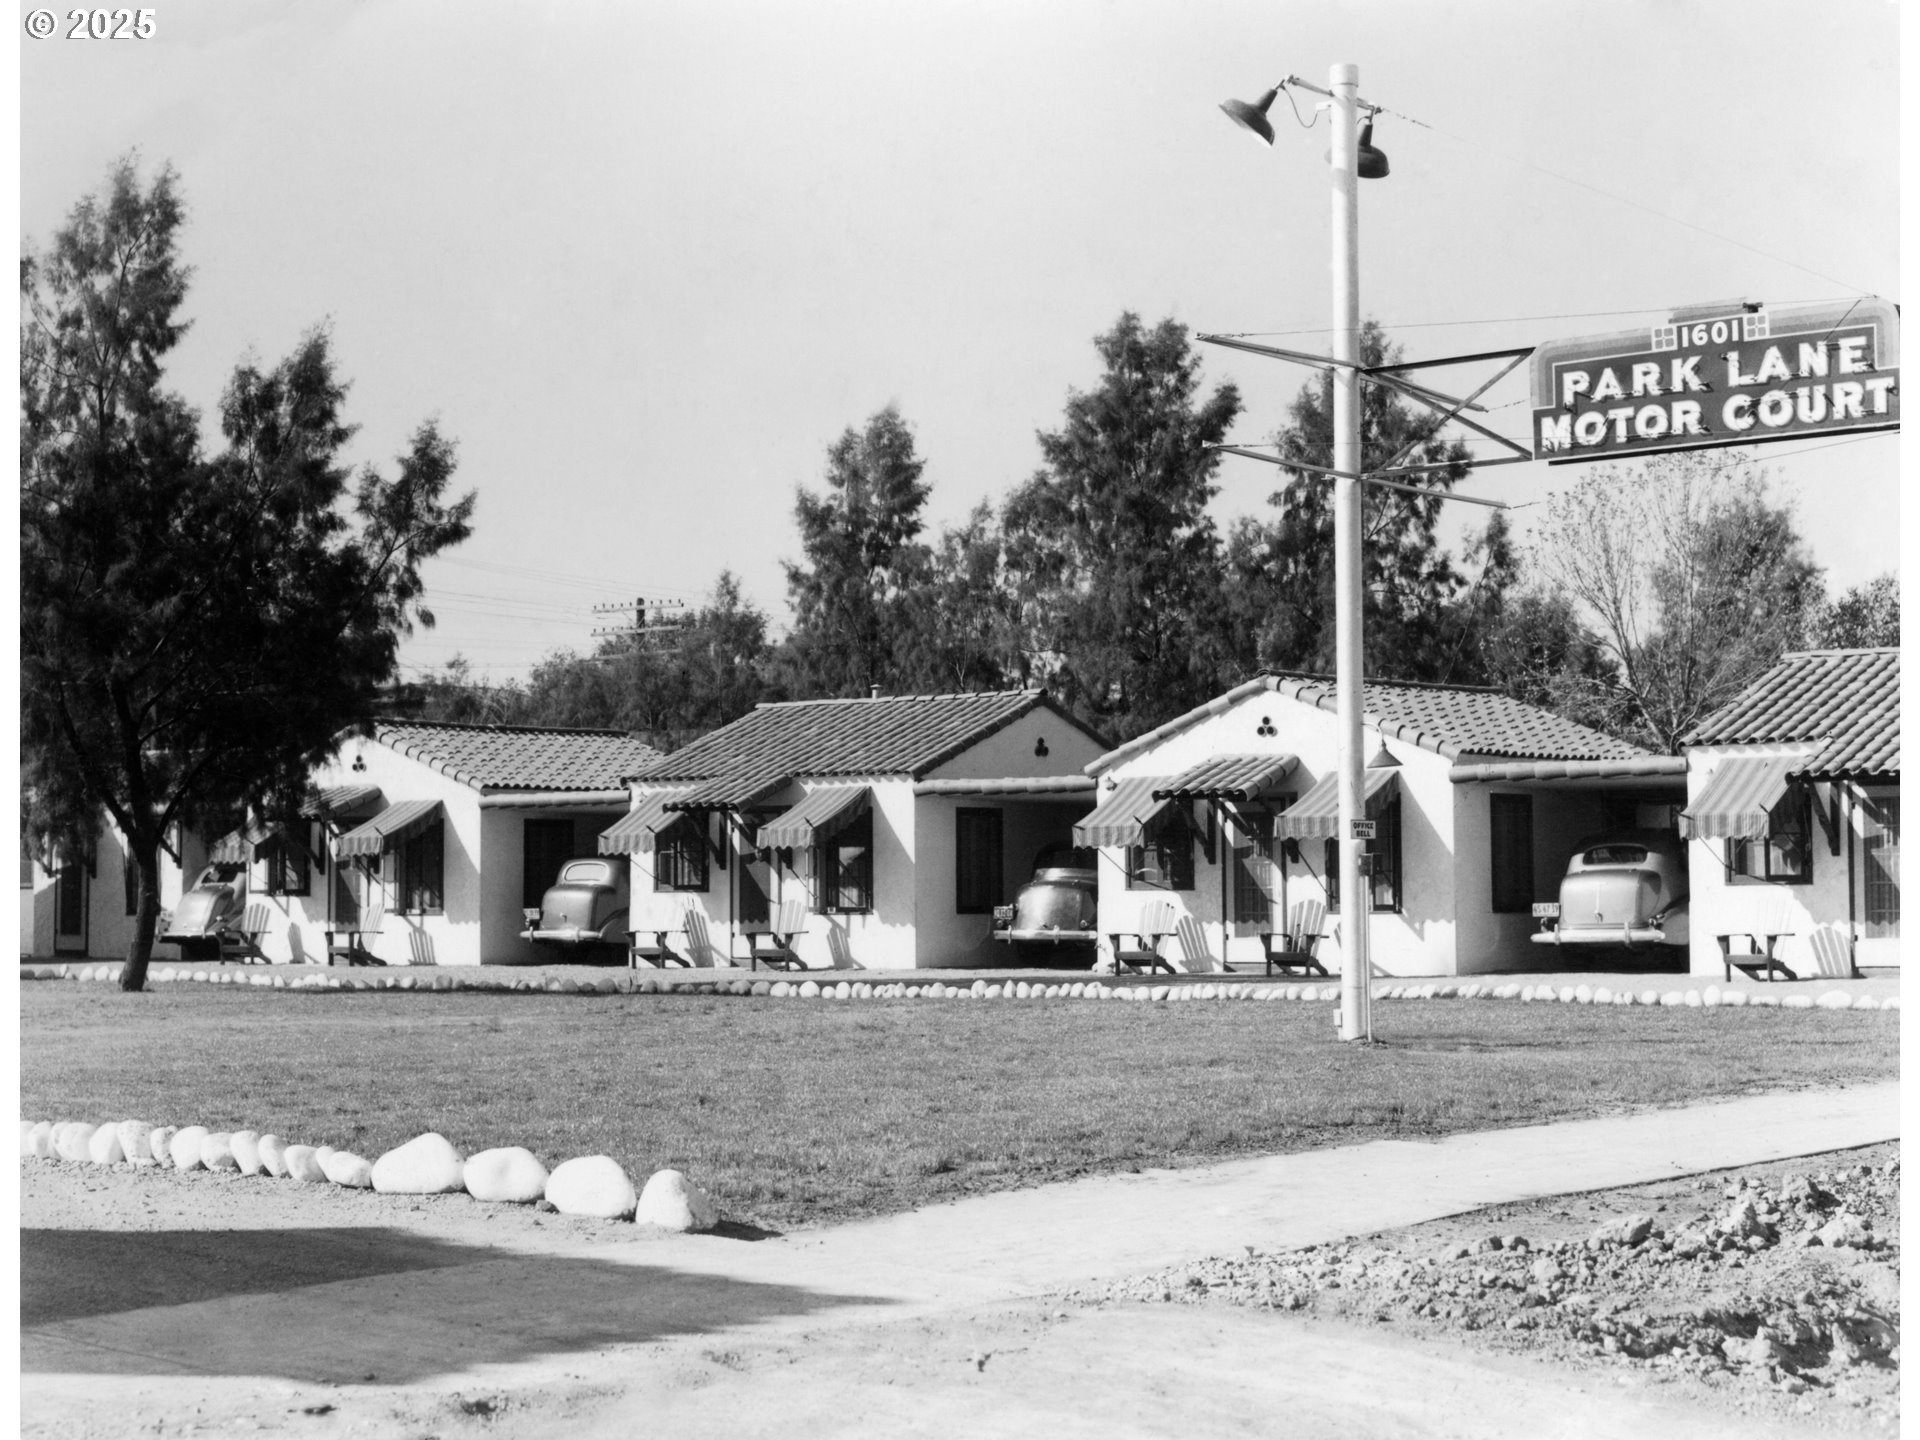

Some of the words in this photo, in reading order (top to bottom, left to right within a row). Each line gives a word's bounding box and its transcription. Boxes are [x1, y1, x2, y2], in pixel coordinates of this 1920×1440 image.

[1681, 319, 1740, 348] 1601
[1562, 356, 1711, 407] PARK
[1723, 336, 1873, 388] LANE
[1540, 400, 1708, 453] MOTOR
[1722, 377, 1896, 431] COURT
